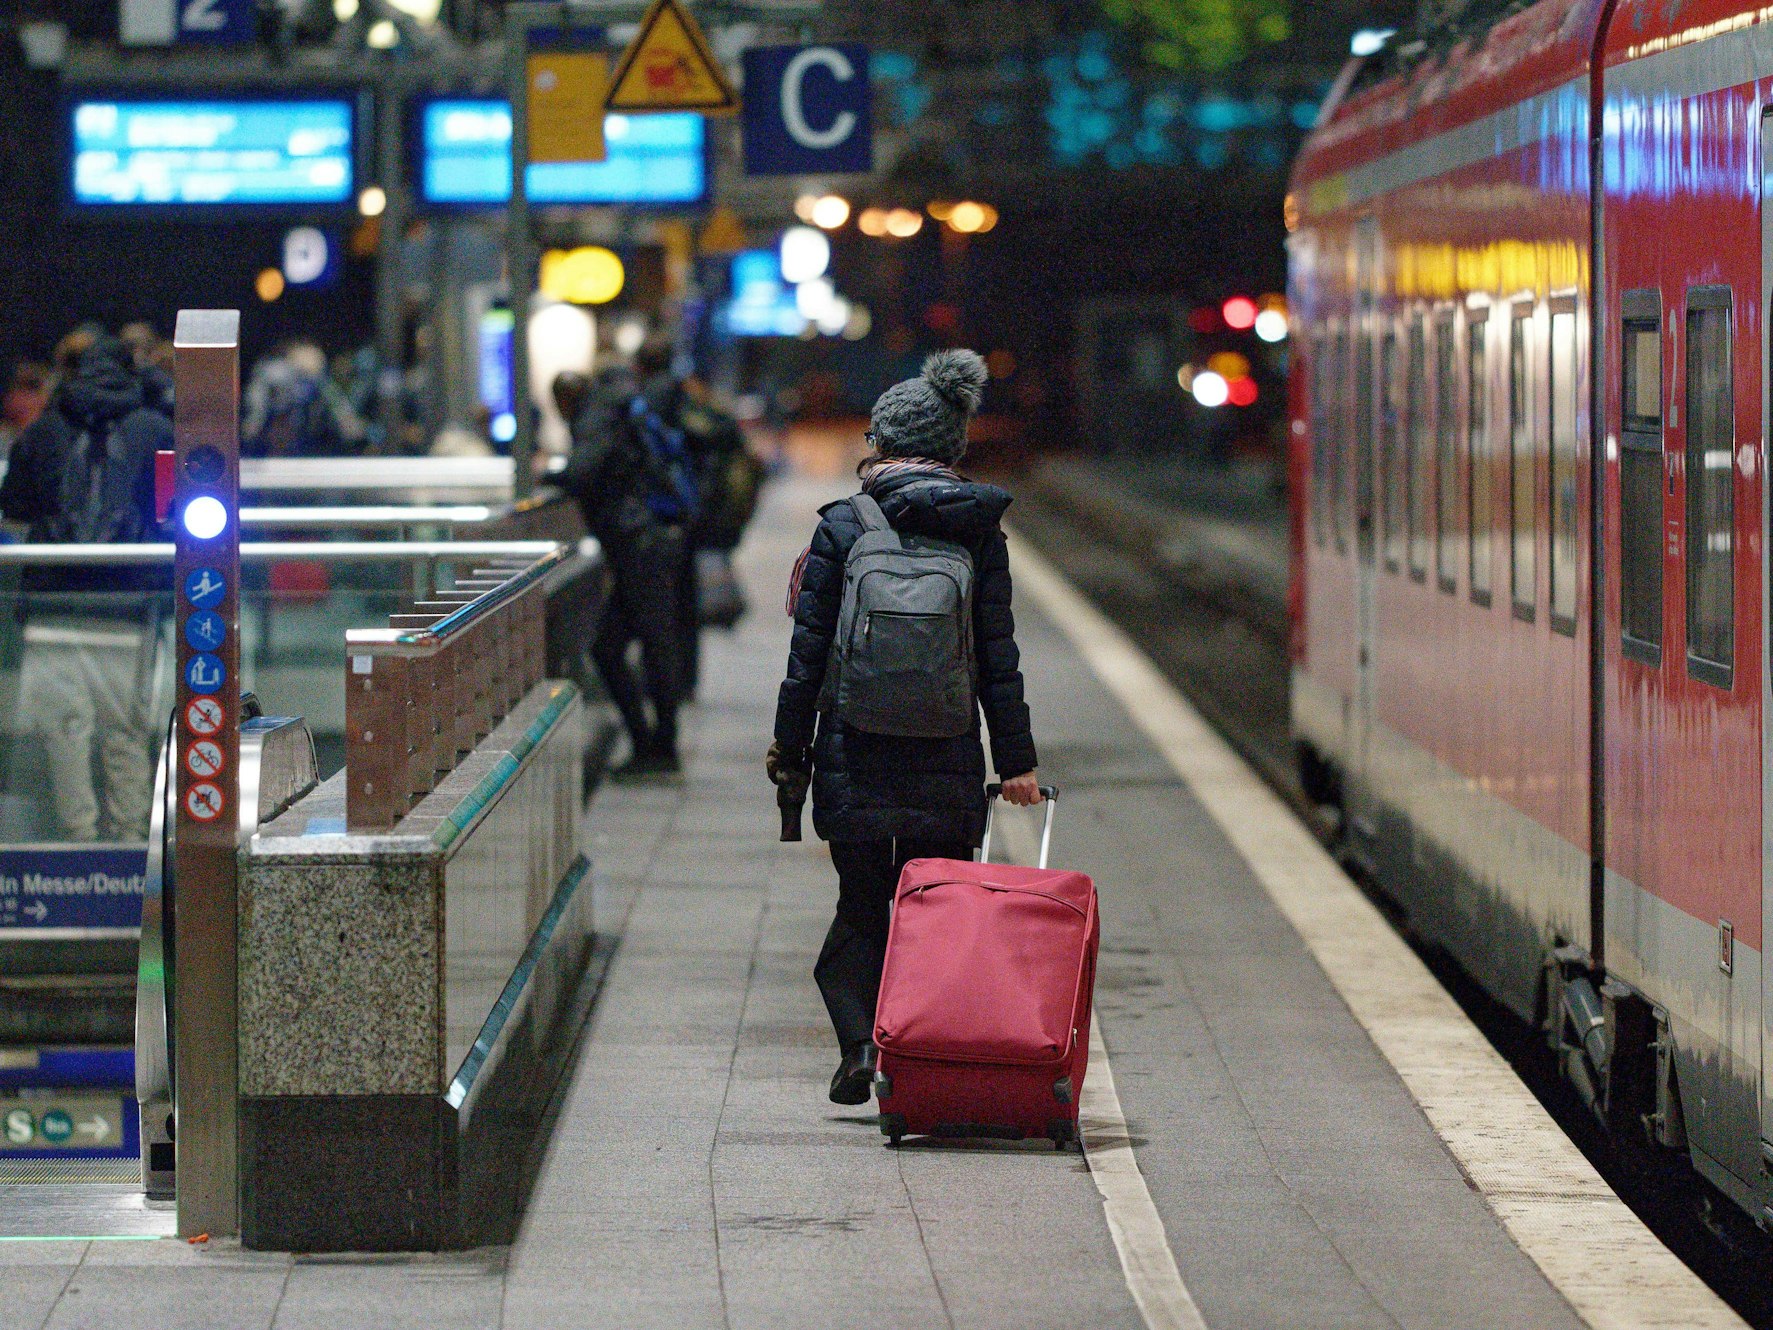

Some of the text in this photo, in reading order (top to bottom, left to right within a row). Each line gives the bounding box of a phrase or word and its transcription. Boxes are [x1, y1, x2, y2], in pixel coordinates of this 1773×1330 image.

[781, 46, 856, 149] C
[1669, 309, 1678, 428] 2
[7, 1110, 34, 1143] S
